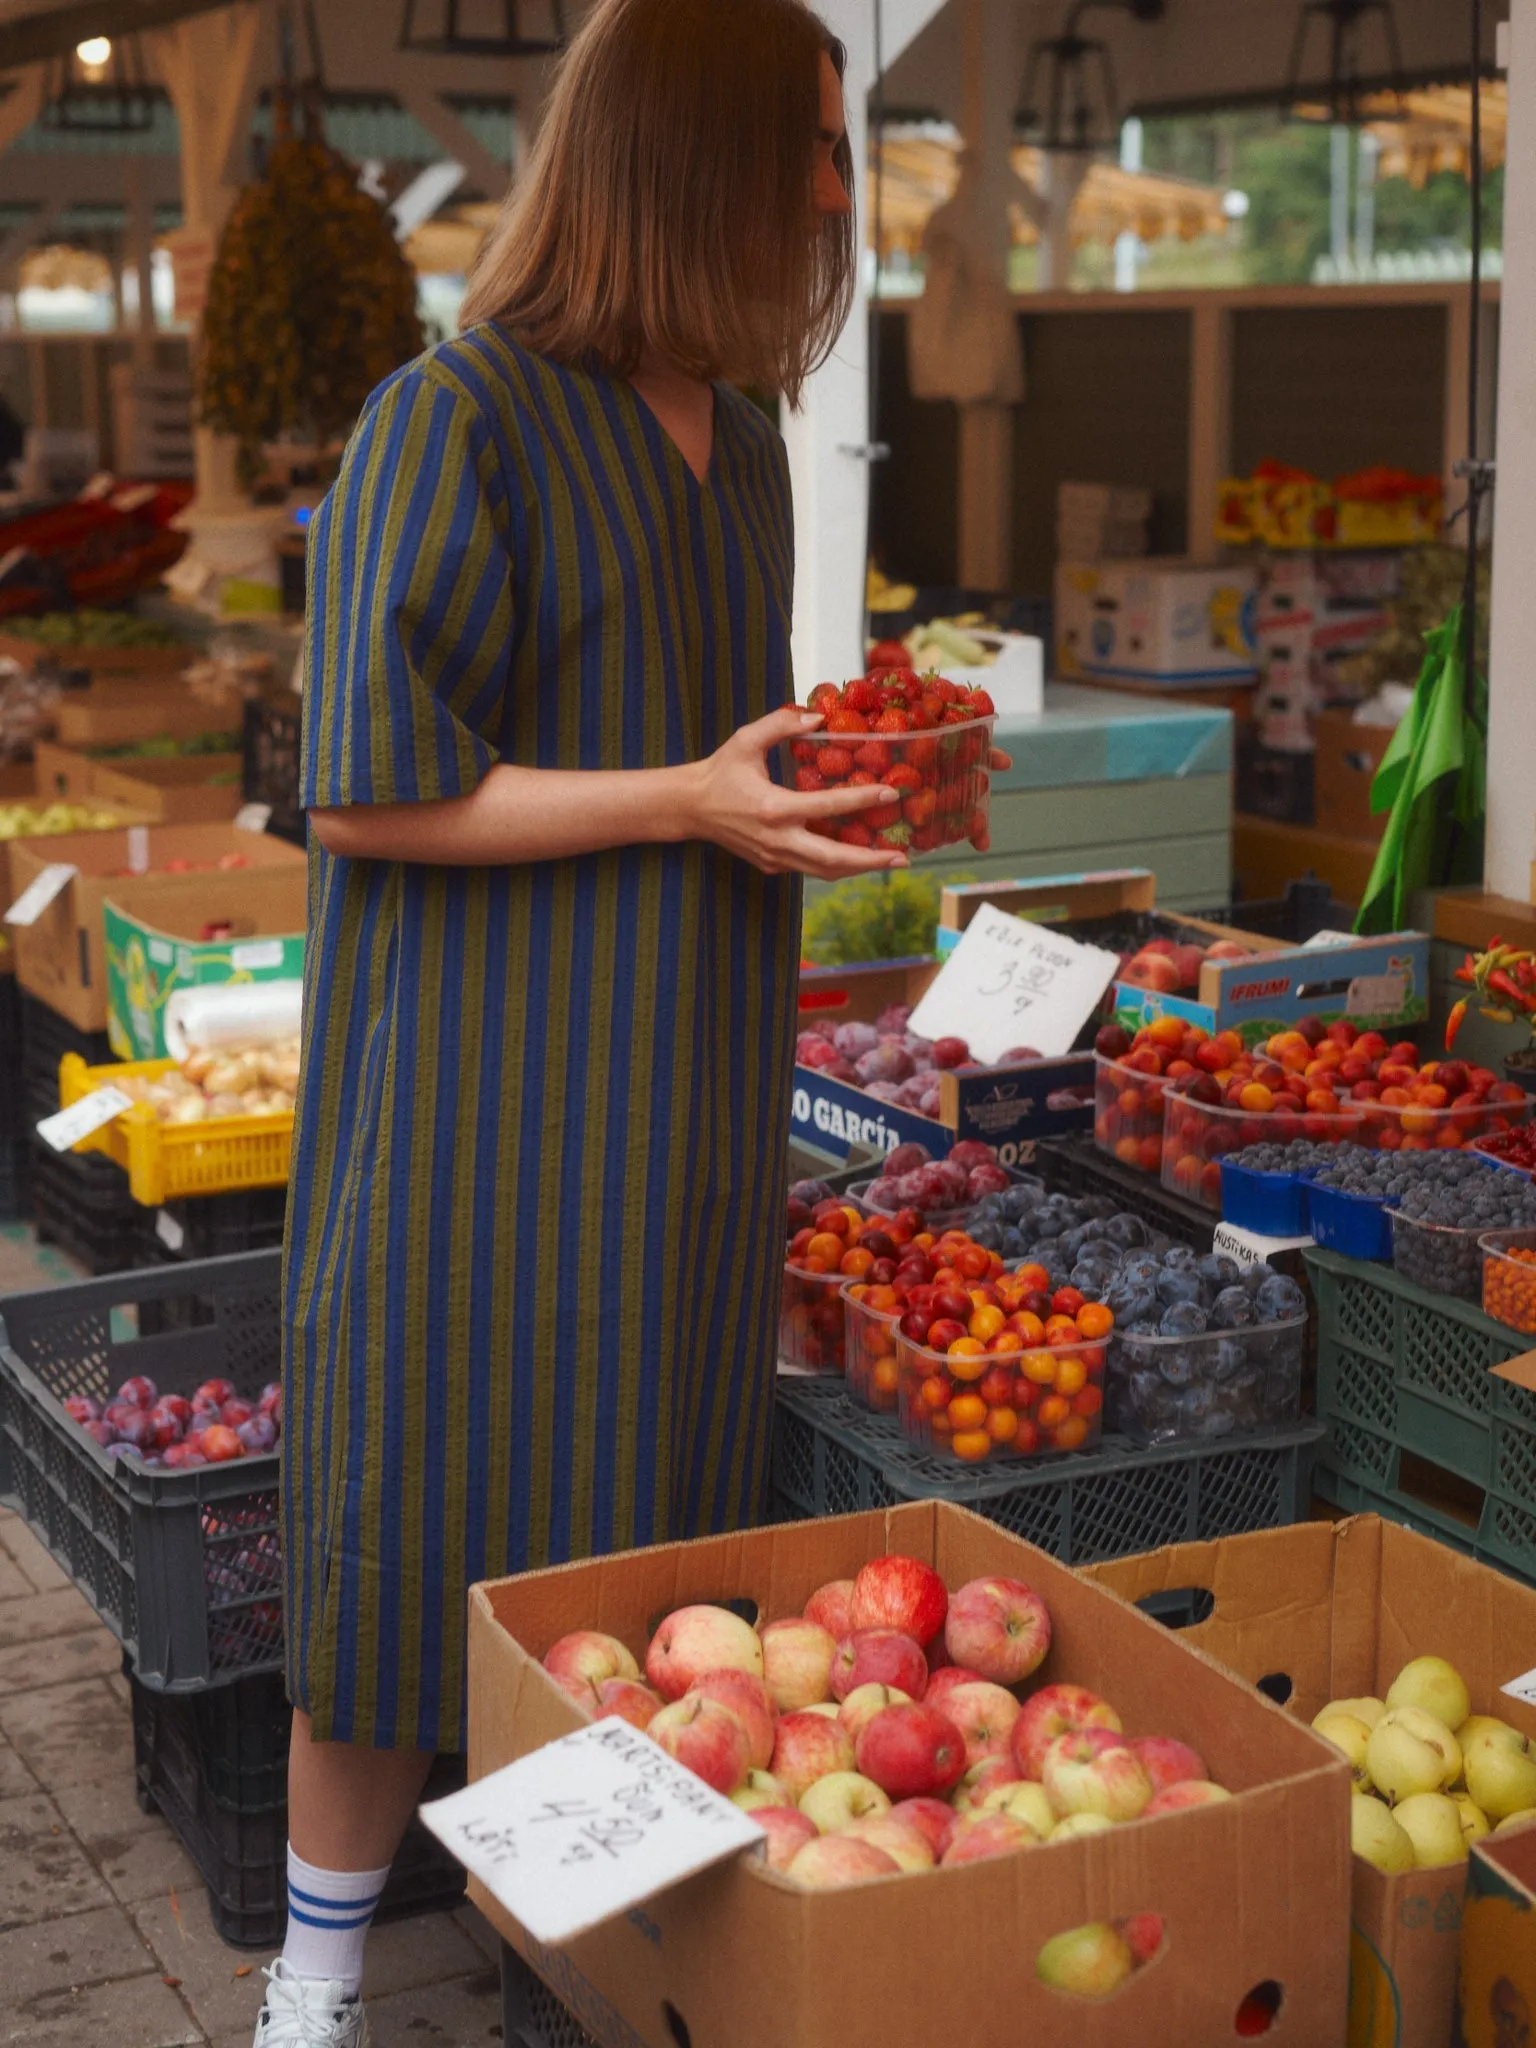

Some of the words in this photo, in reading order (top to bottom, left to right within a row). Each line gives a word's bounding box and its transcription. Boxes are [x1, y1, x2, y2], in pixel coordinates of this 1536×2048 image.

[978, 960, 1019, 996] 3
[1229, 976, 1292, 1001] IFRUMI
[791, 1088, 810, 1123] O
[813, 1097, 900, 1156] GARCÍA
[989, 1139, 1036, 1166] OZ
